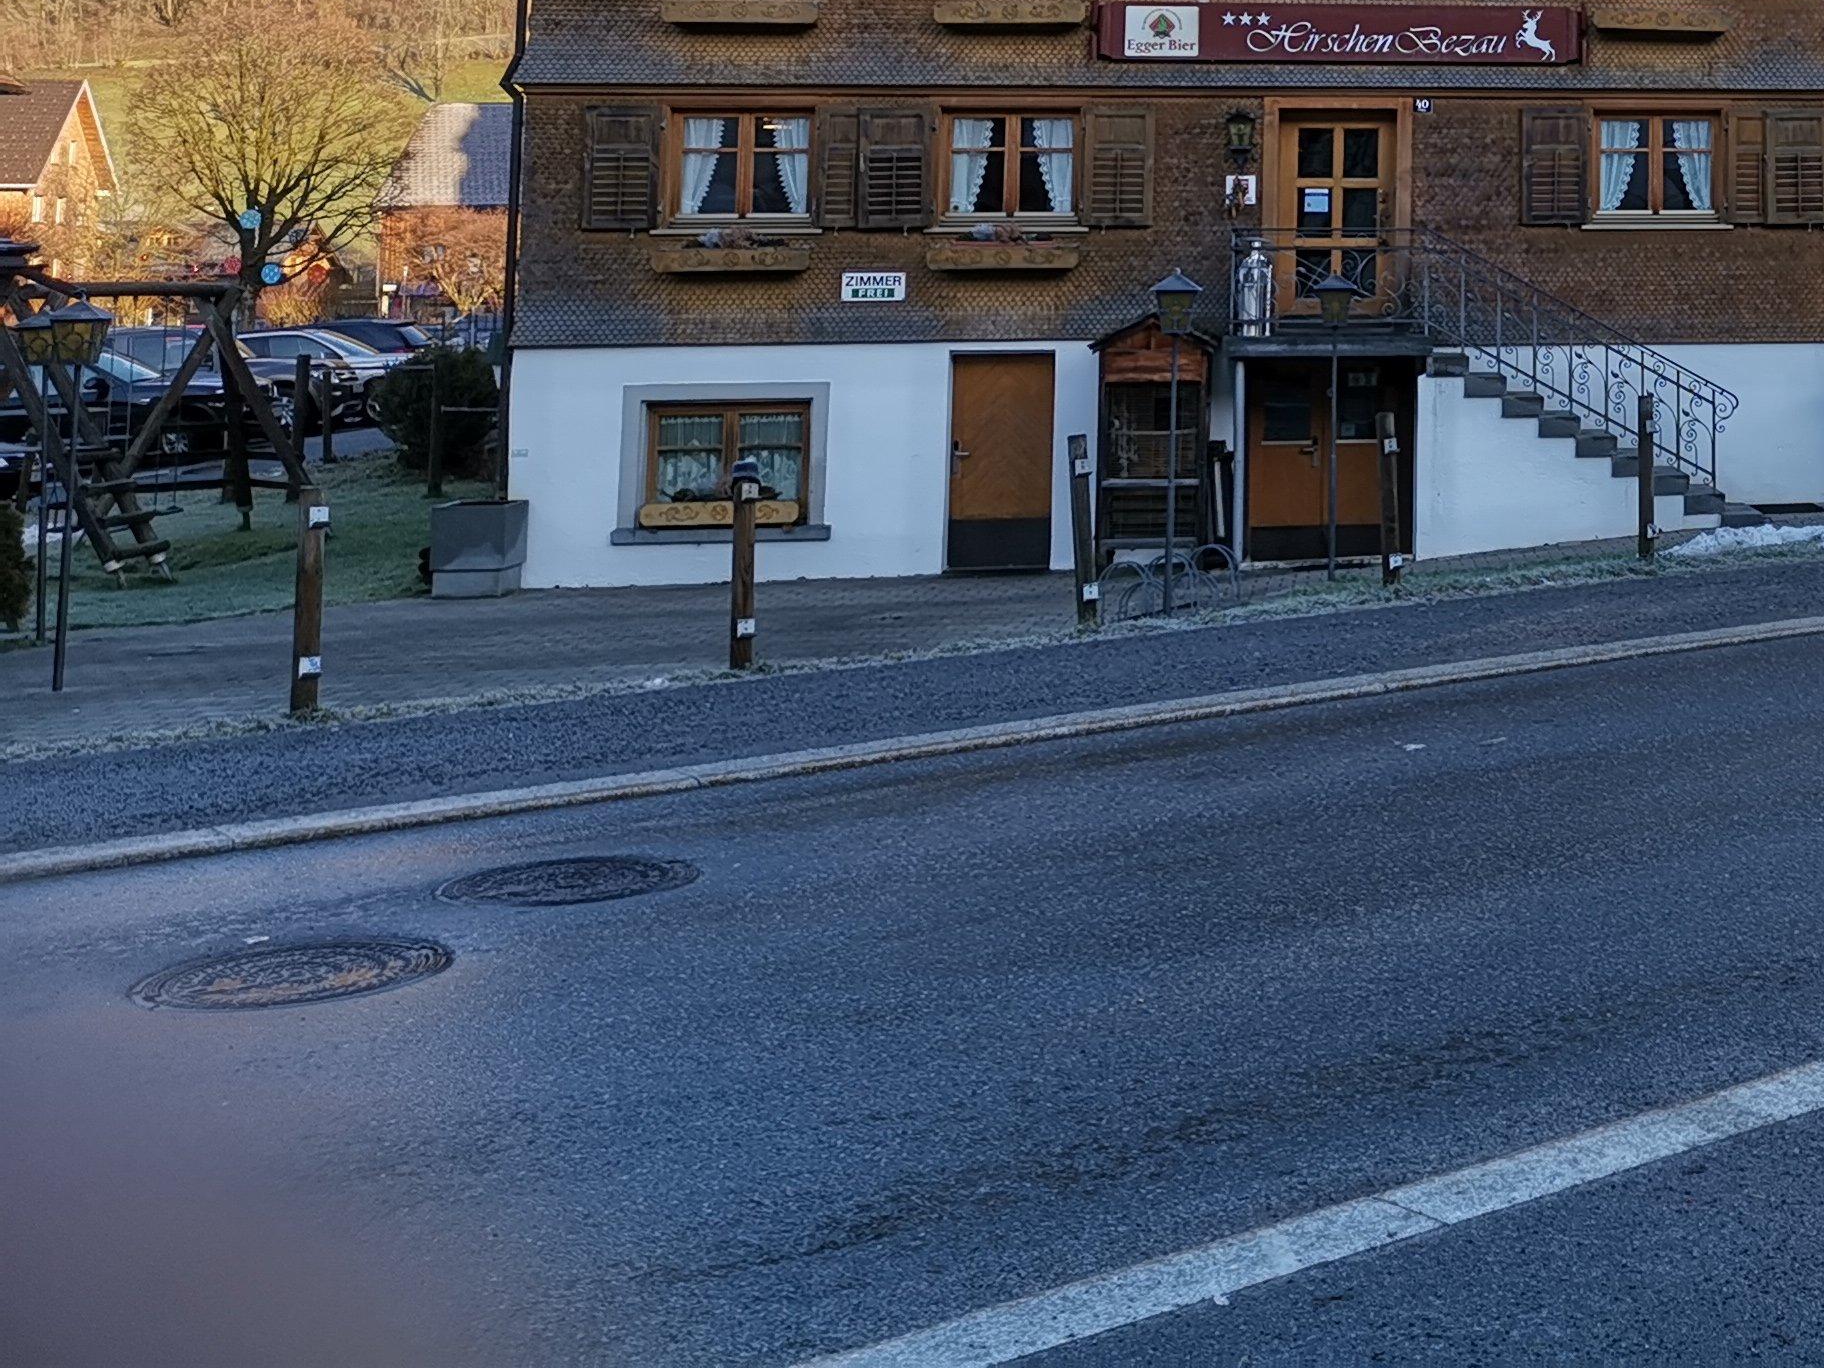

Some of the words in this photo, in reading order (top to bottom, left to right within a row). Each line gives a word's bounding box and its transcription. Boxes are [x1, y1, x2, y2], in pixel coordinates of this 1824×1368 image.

[1246, 21, 1394, 53] Hirschen
[1395, 26, 1507, 57] Bezau
[1126, 39, 1165, 54] Egger
[1168, 39, 1197, 51] Bier
[1415, 98, 1430, 109] 40
[845, 275, 902, 287] ZIMMER
[858, 288, 889, 298] FREI
